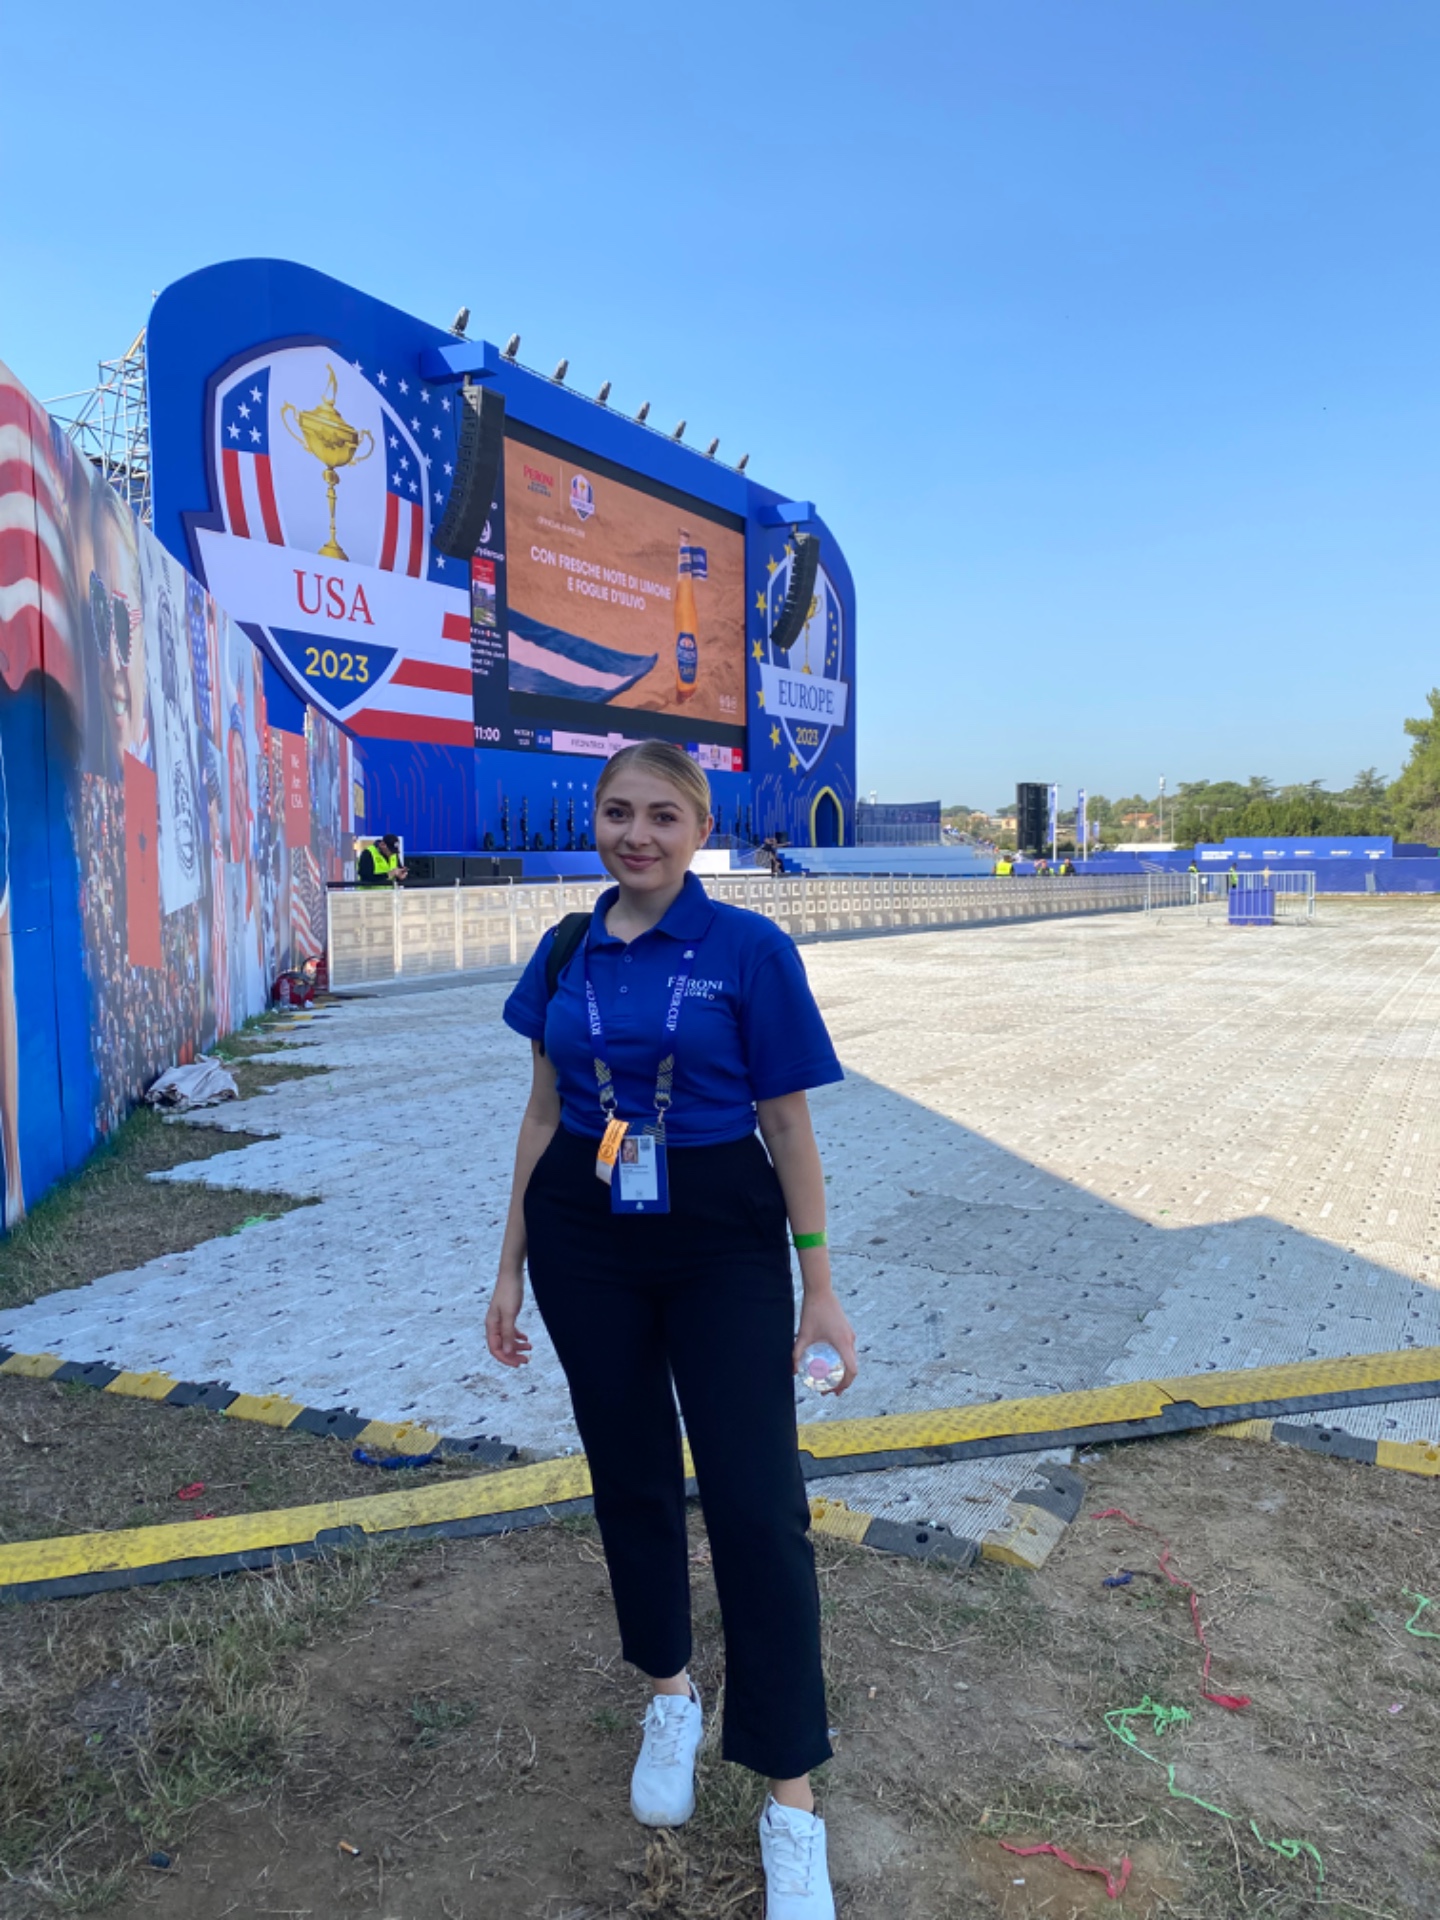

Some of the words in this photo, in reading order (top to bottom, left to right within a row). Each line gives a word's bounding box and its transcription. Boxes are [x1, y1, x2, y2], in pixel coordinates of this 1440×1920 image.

[531, 546, 556, 566] CON
[558, 554, 600, 580] FRESCHE
[603, 567, 627, 588] NOTE
[628, 575, 639, 590] DI
[640, 578, 671, 600] LIMONE
[293, 569, 375, 625] USA
[567, 576, 574, 591] E
[575, 578, 608, 601] FOGLIE
[611, 588, 646, 610] D'ULIVO
[305, 647, 369, 683] 2023
[778, 679, 834, 715] EUROPE
[474, 726, 501, 741] 11:00
[796, 727, 819, 746] 2023
